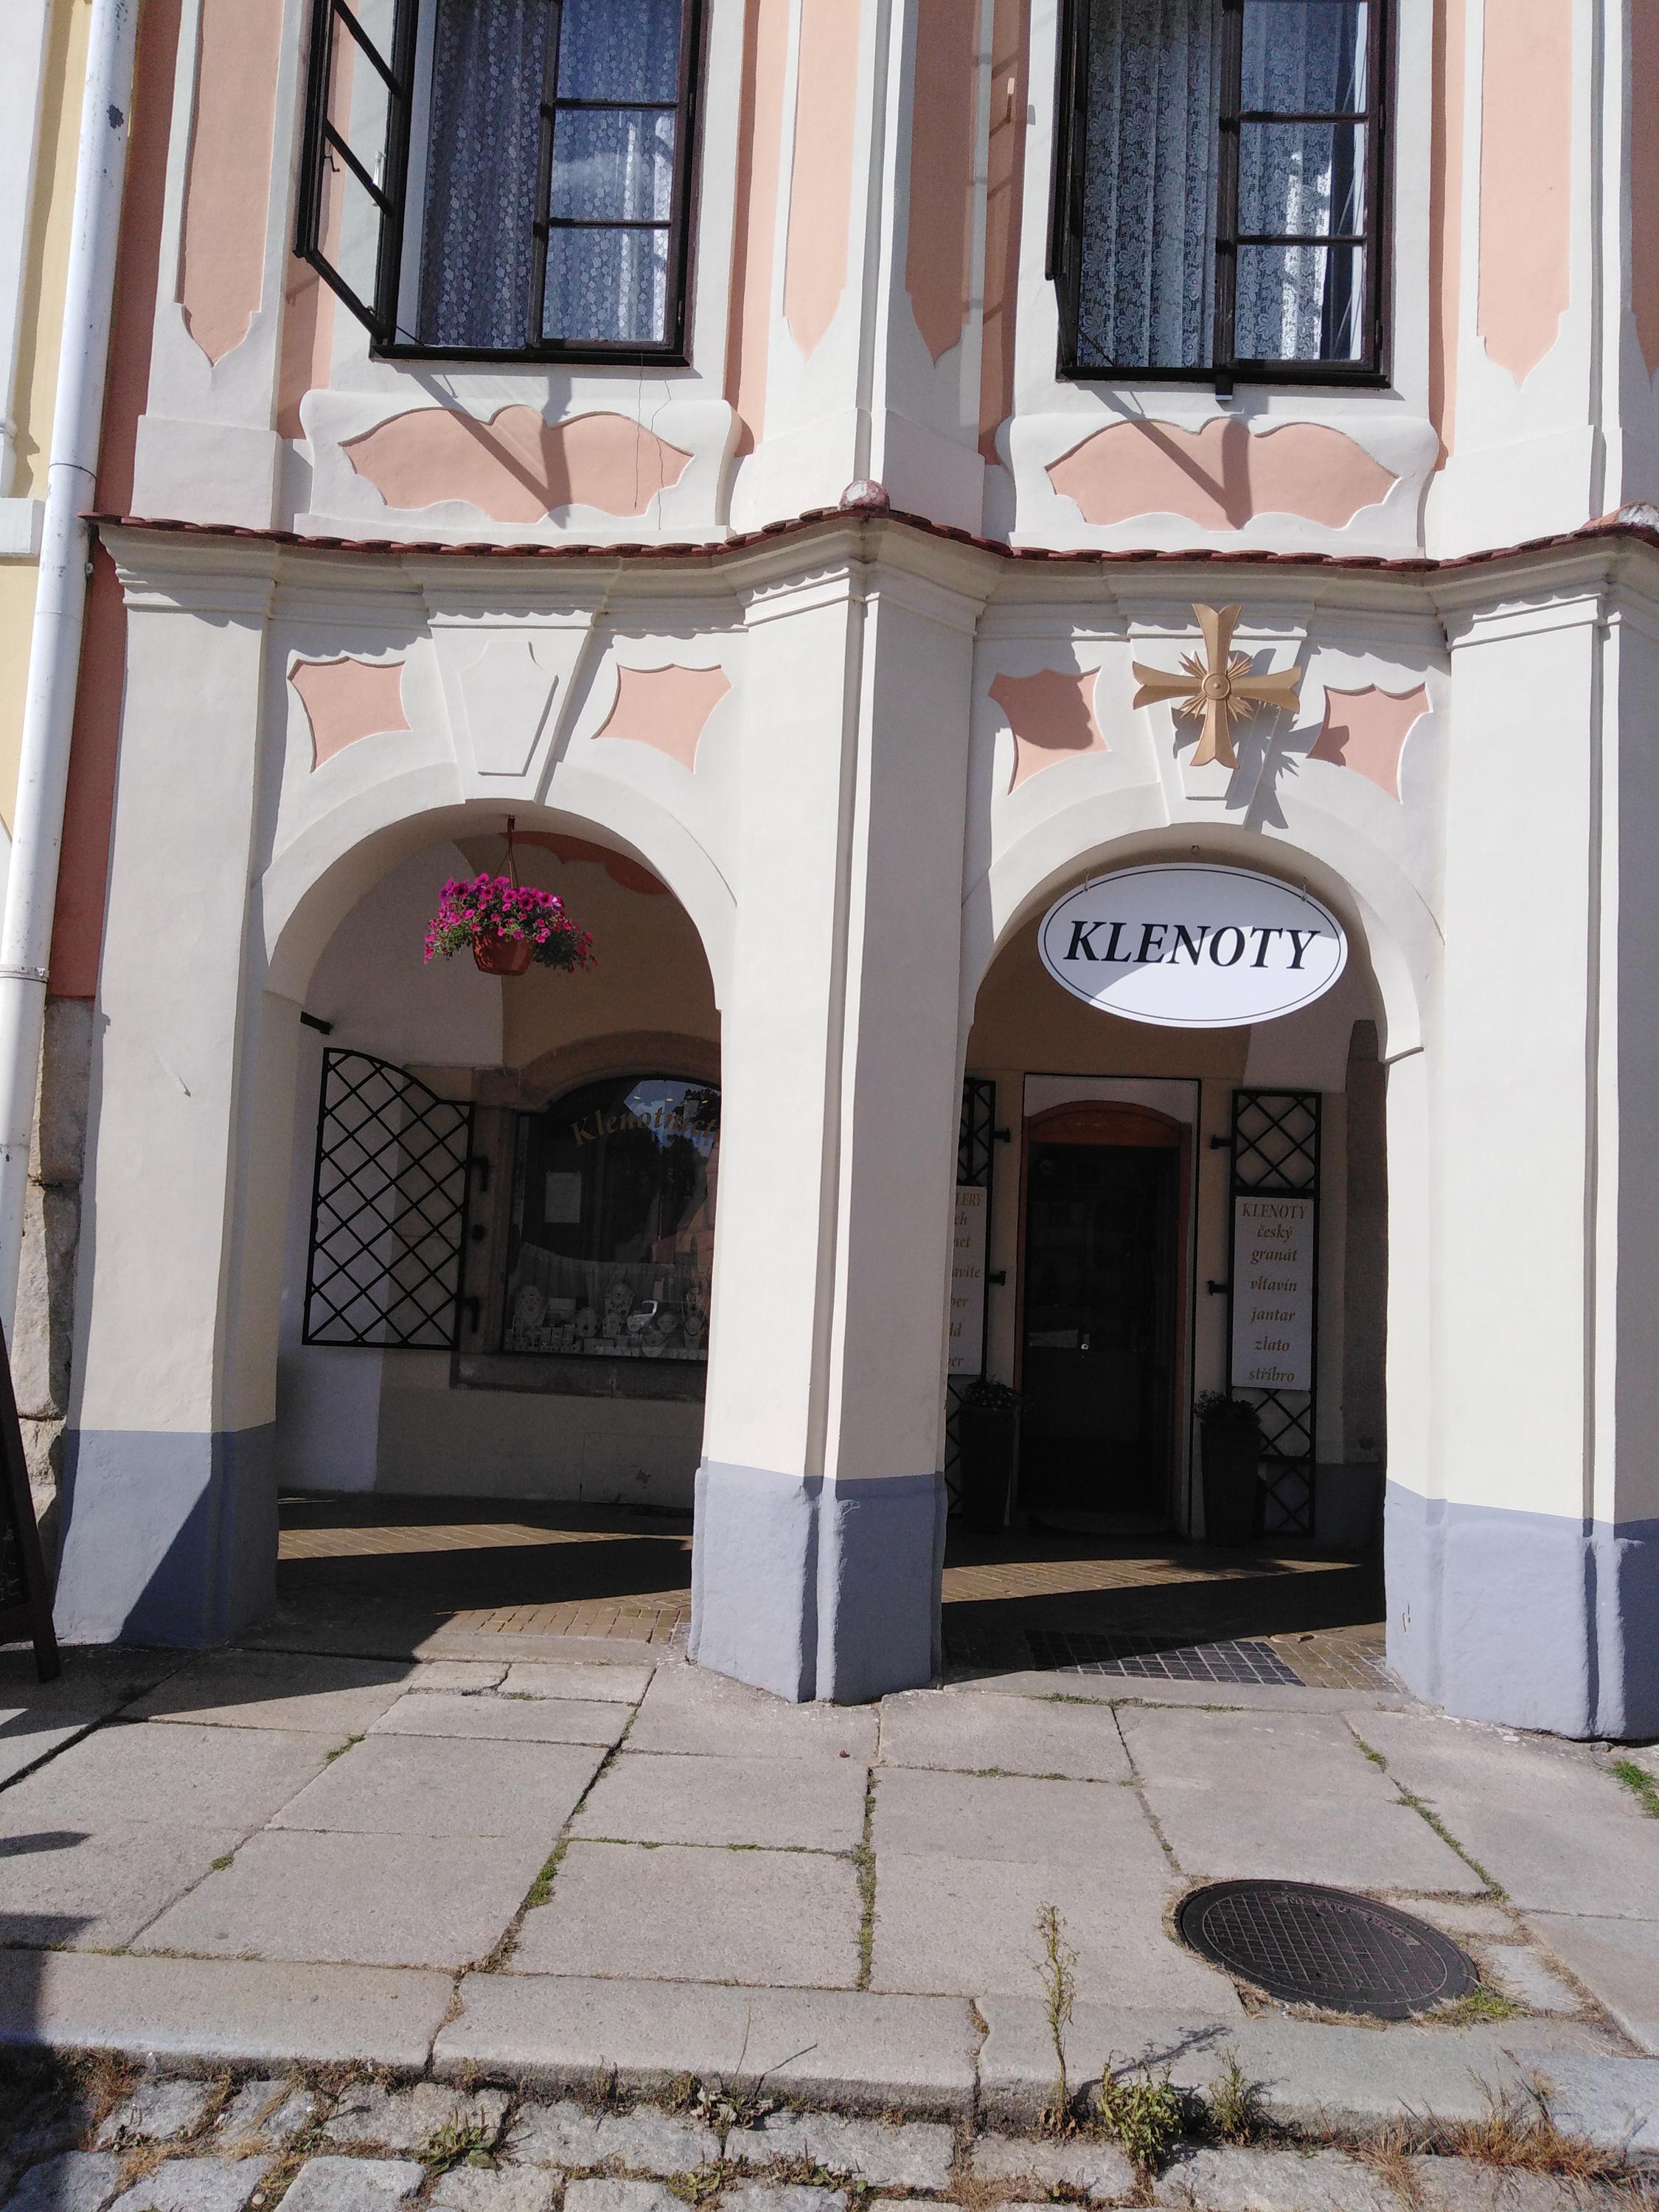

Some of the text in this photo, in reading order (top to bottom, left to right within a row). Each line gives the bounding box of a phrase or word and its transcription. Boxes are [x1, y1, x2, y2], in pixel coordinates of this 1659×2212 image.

[1062, 919, 1321, 970] KLENOTY
[568, 1106, 718, 1148] Klenotnict
[1242, 1202, 1308, 1220] KLENOTY
[1256, 1223, 1293, 1243] český
[1250, 1248, 1298, 1265] granát
[952, 1265, 981, 1278] avite
[1250, 1276, 1297, 1293] vltavín
[1250, 1306, 1295, 1324] jantar
[1254, 1336, 1290, 1352] zlato
[1248, 1366, 1295, 1382] stříbro
